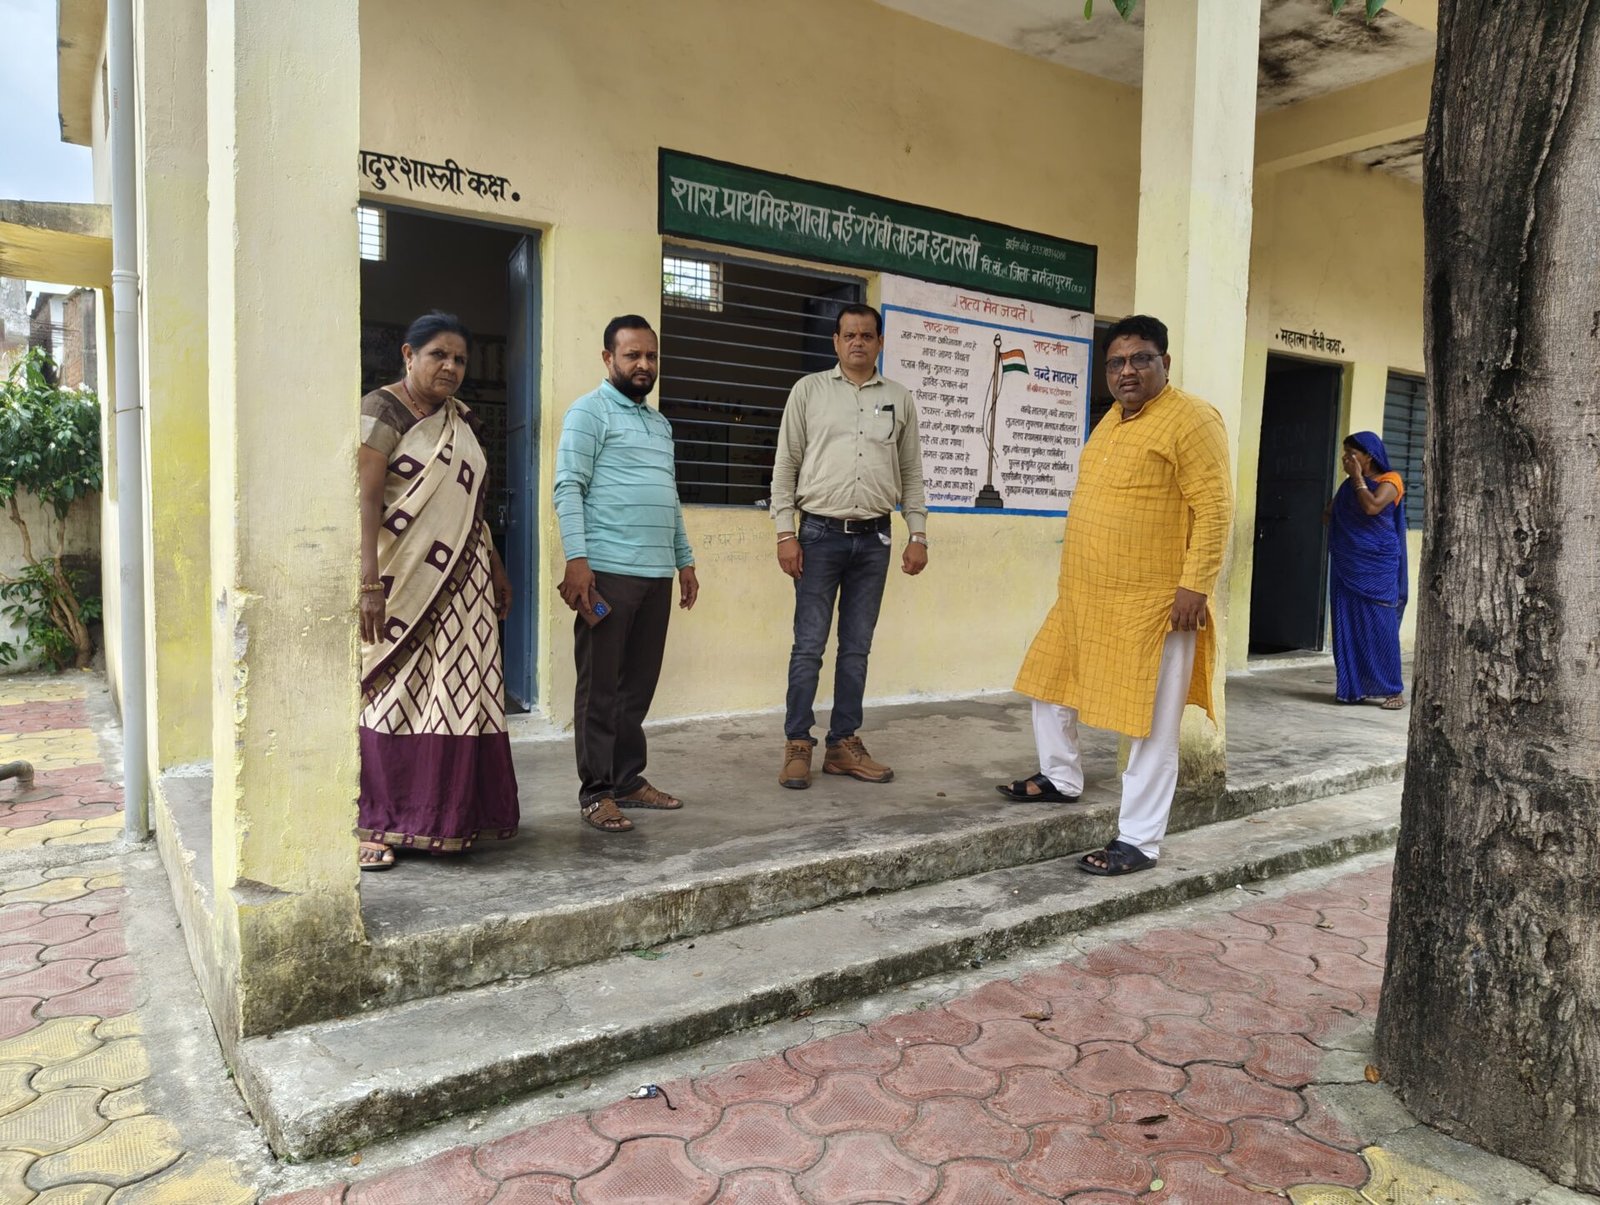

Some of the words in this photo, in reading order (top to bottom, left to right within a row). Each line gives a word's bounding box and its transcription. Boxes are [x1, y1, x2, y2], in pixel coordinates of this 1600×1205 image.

[400, 156, 466, 195] शास्त्री
[721, 187, 791, 231] प्राथमिक
[832, 205, 855, 246] नई
[855, 212, 893, 250] गरीबी
[1280, 328, 1307, 349] महात्मा
[1034, 366, 1050, 382] वन्दे
